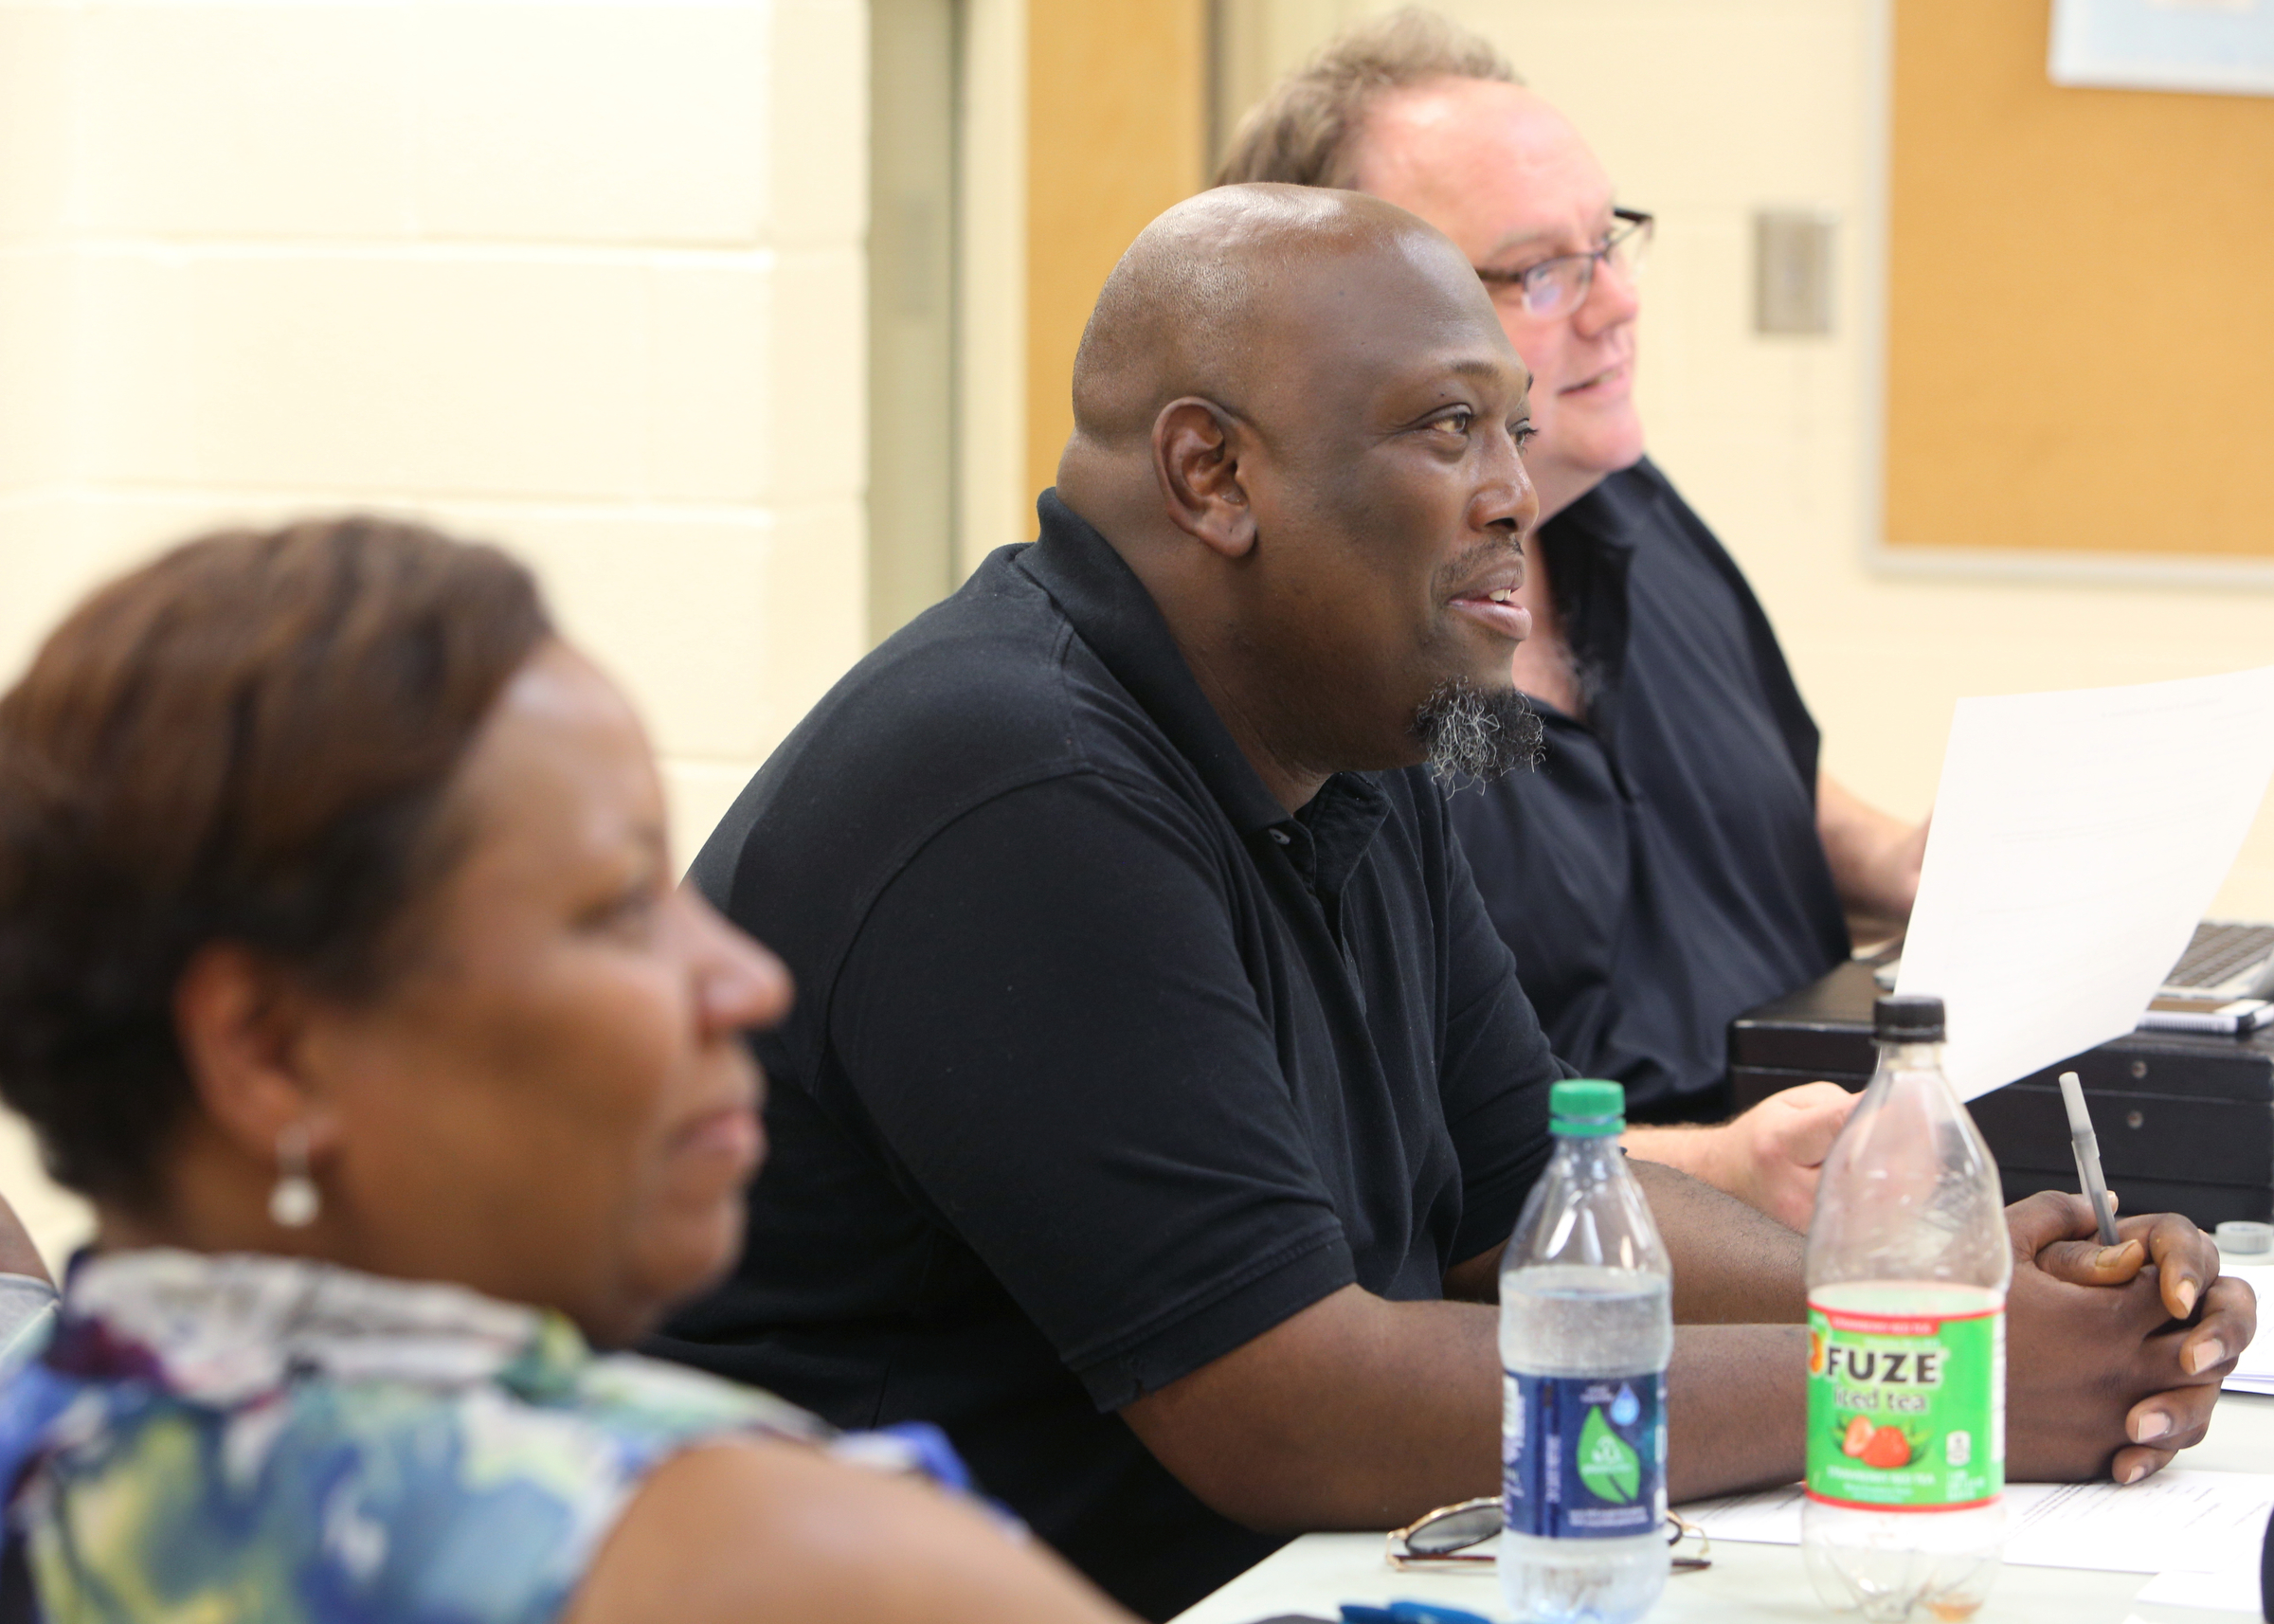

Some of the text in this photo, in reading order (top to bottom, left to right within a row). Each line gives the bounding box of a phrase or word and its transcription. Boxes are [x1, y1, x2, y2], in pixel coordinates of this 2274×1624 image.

[1829, 1347, 1936, 1382] FUZE
[1834, 1386, 1925, 1411] iced tea
